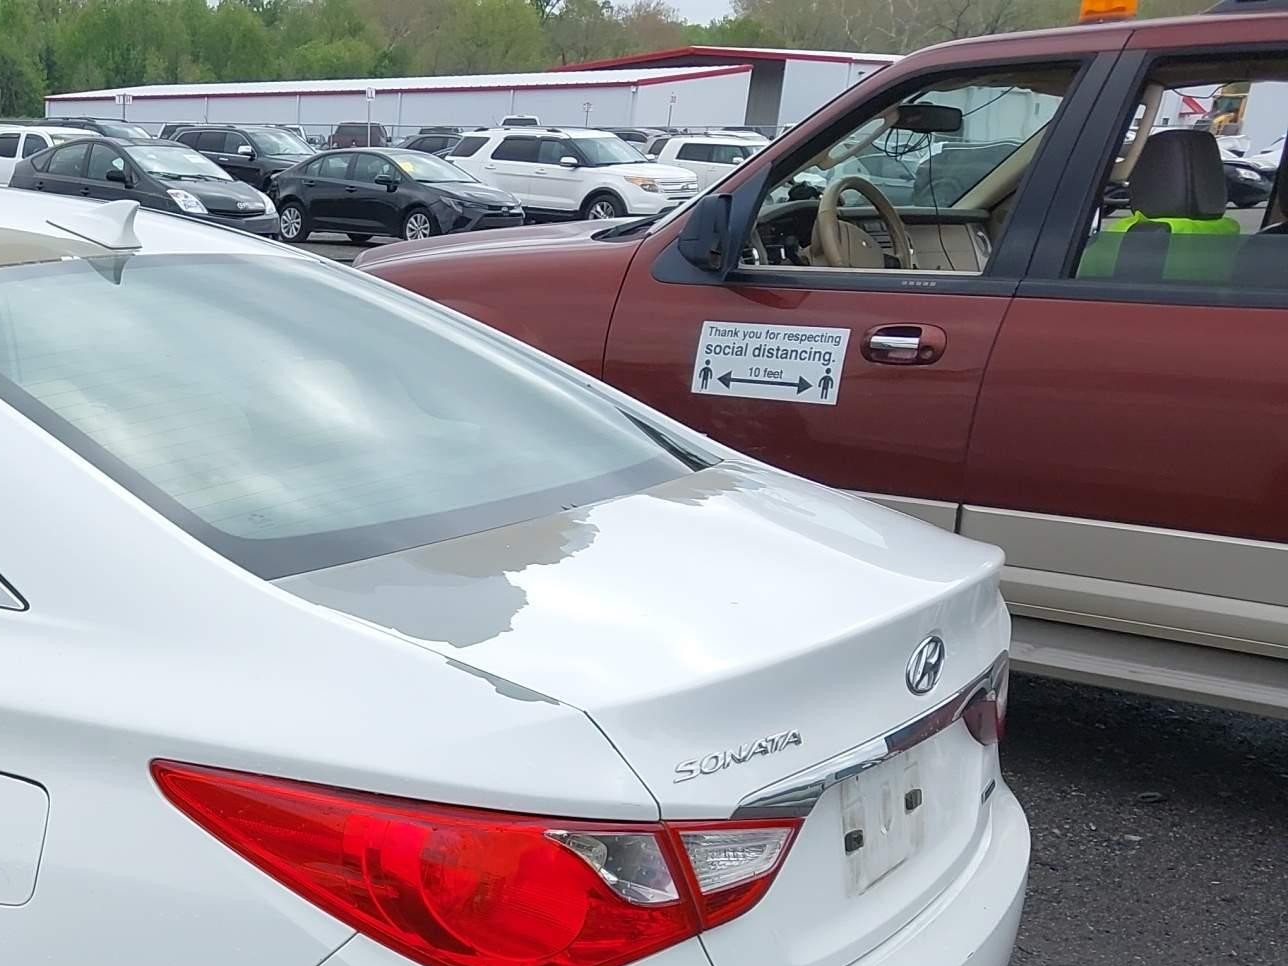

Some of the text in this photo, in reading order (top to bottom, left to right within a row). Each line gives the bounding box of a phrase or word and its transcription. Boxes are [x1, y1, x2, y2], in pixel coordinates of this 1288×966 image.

[708, 326, 842, 347] Thank you for respecting
[704, 342, 836, 366] social distancing.
[748, 367, 784, 380] 10 feet
[673, 729, 803, 784] SONATA
